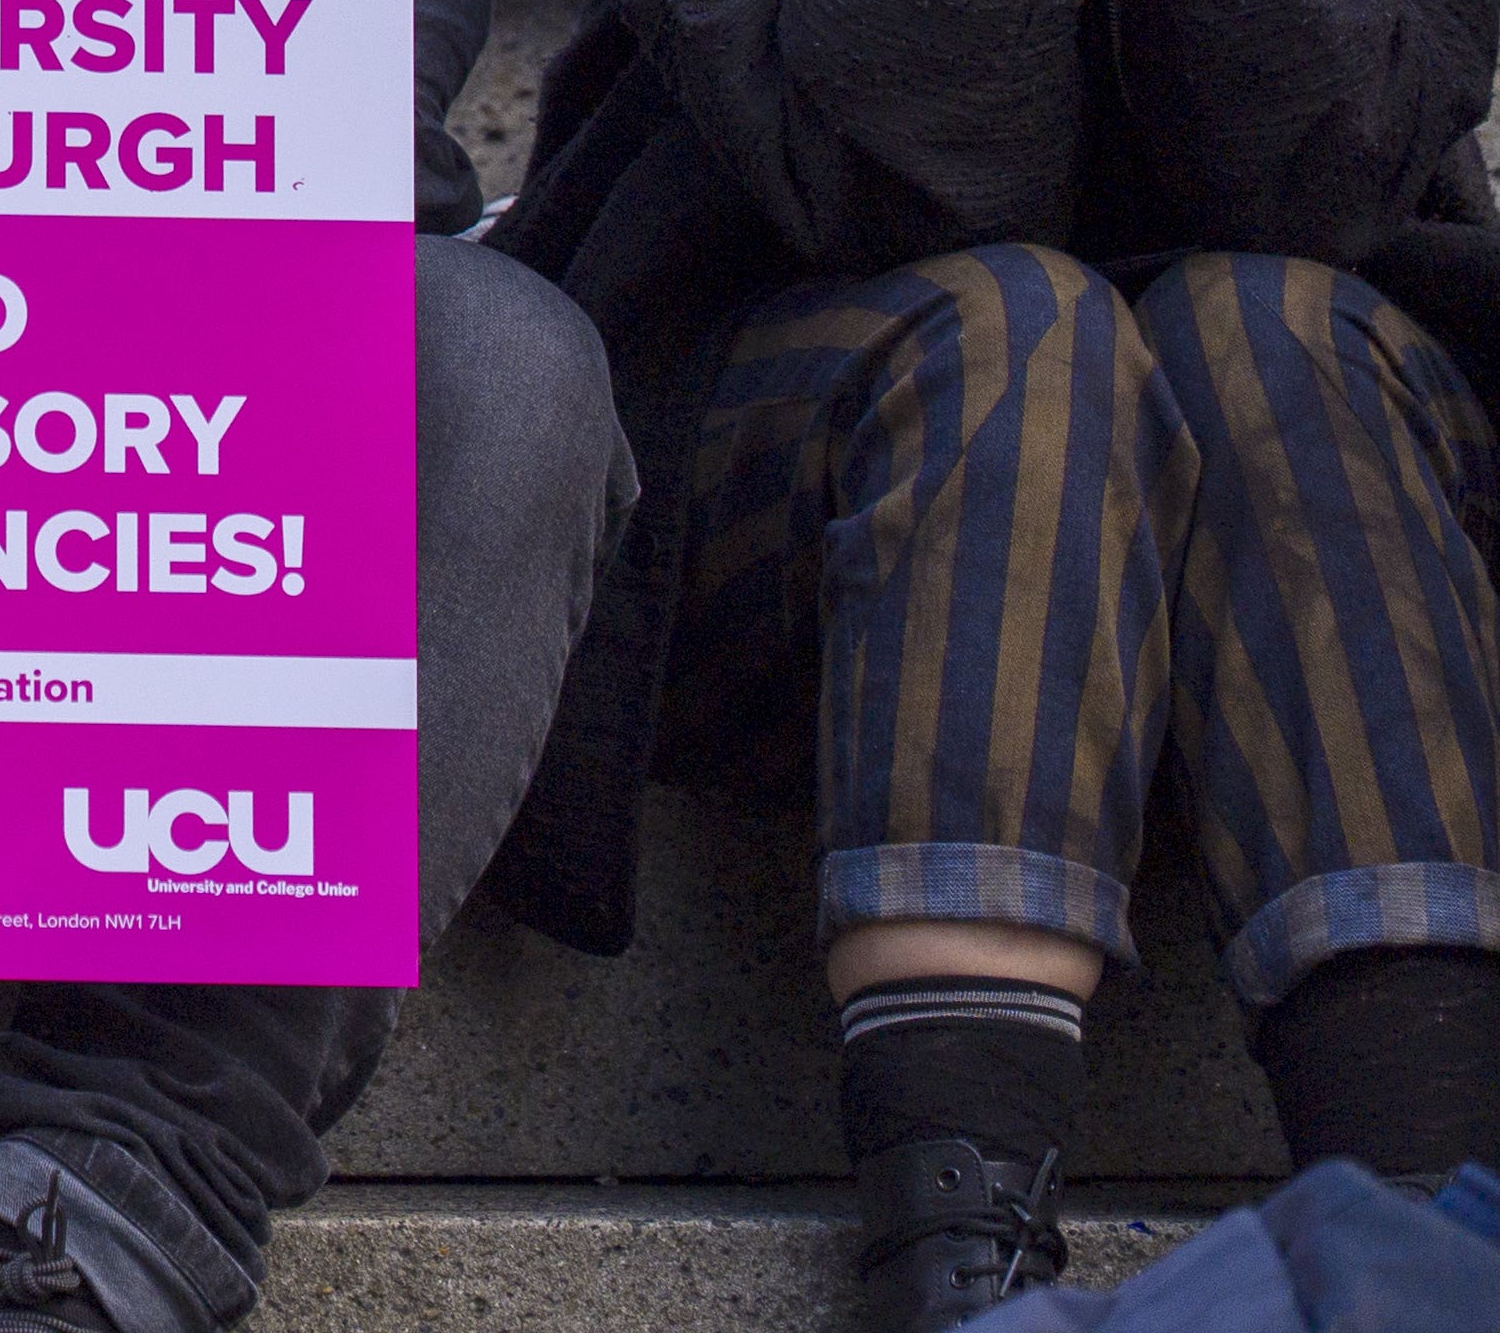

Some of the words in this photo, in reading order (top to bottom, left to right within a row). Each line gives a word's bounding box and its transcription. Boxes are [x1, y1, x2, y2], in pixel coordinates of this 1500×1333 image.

[147, 877, 222, 897] University
[226, 879, 254, 895] and
[257, 879, 314, 899] College
[38, 910, 100, 928] London
[105, 913, 144, 929] NW1
[148, 913, 181, 930] 7LH
